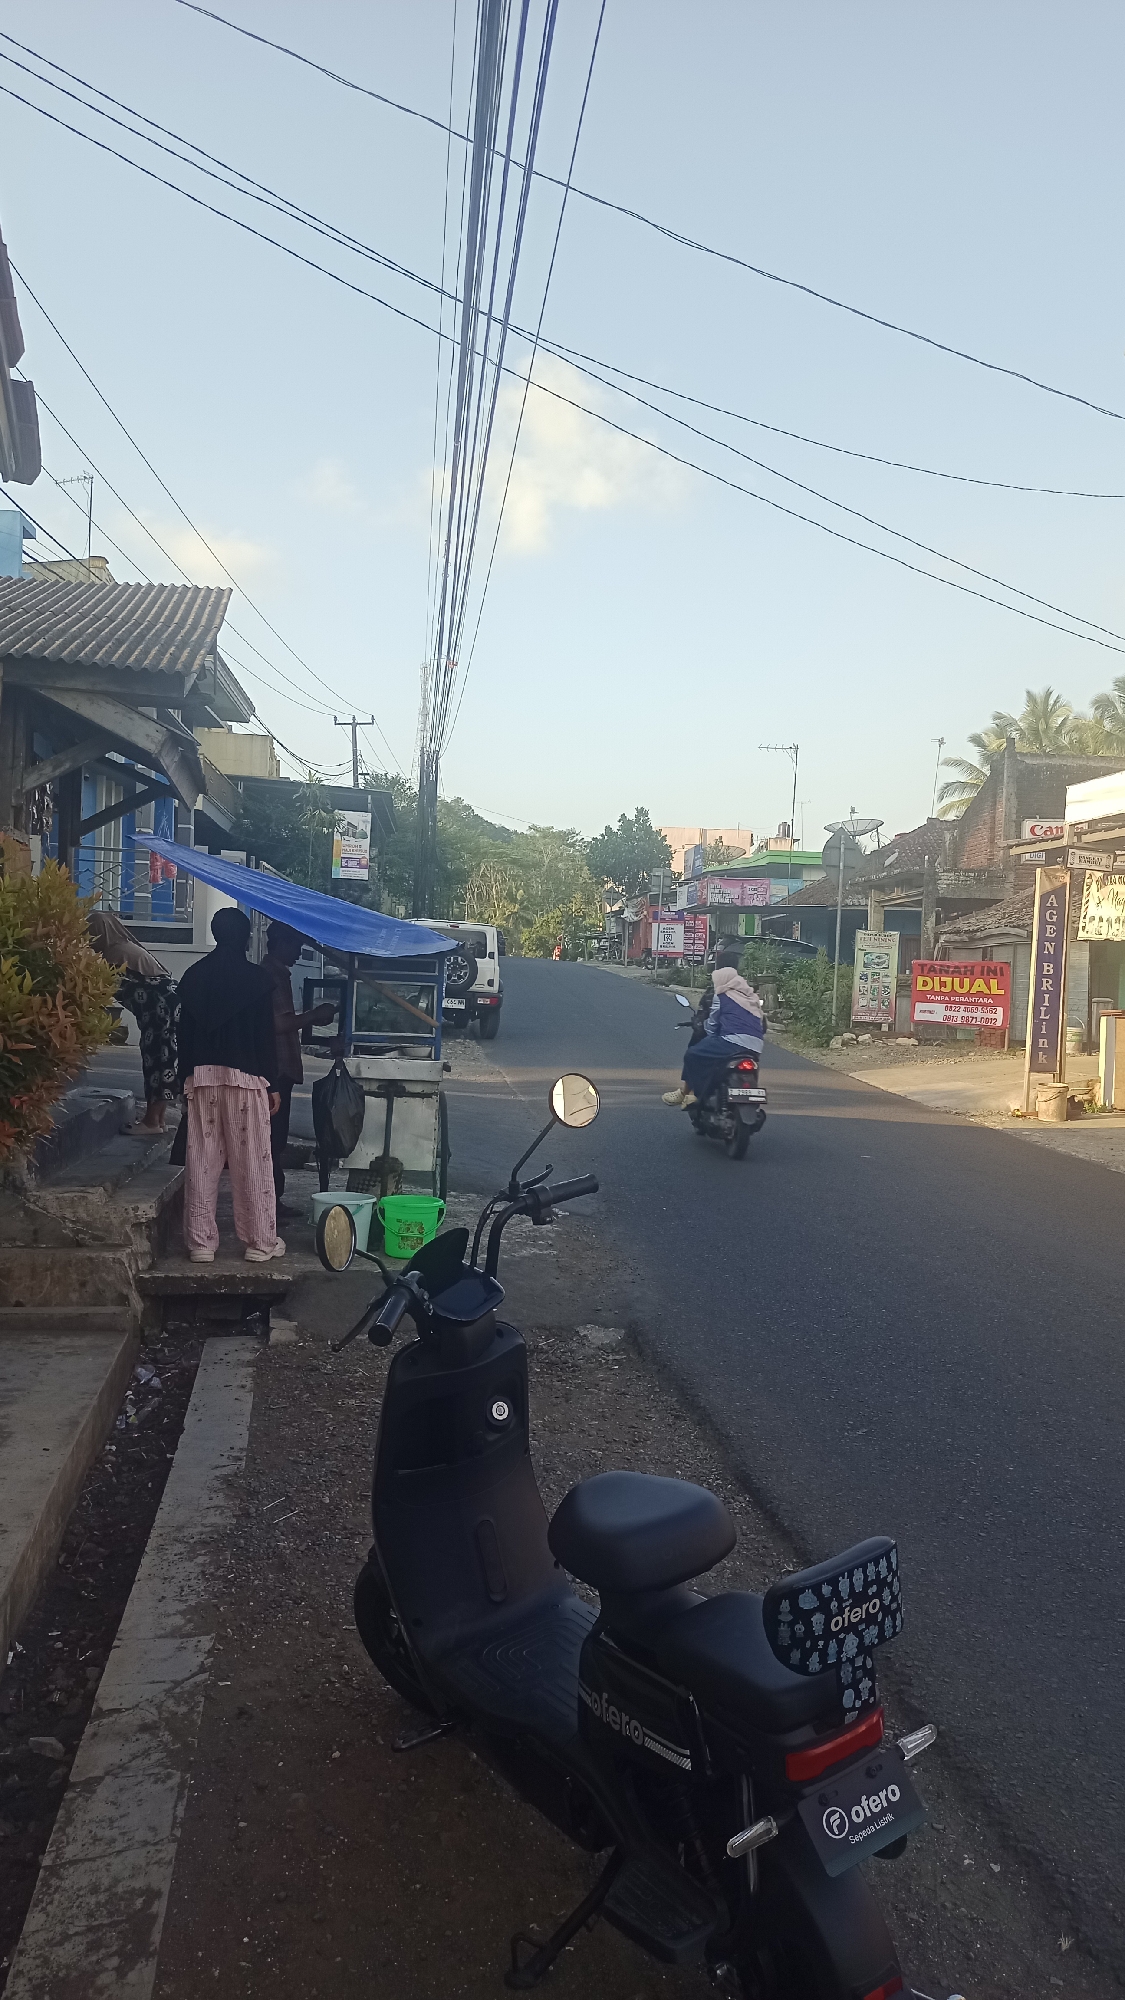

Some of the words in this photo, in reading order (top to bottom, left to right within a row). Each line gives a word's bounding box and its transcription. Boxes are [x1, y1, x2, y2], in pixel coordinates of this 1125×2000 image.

[1043, 894, 1059, 955] AGEN
[916, 975, 1005, 995] DIJUAL
[918, 963, 975, 976] TANAH
[980, 965, 1005, 977] INI
[951, 996, 993, 1004] PERANTARA
[1037, 962, 1054, 1064] BRILink
[830, 1598, 880, 1631] ofero
[591, 1691, 644, 1745] ofero
[850, 1784, 901, 1823] ofero
[848, 1825, 876, 1844] Sepeda
[873, 1812, 895, 1830] Listrik
